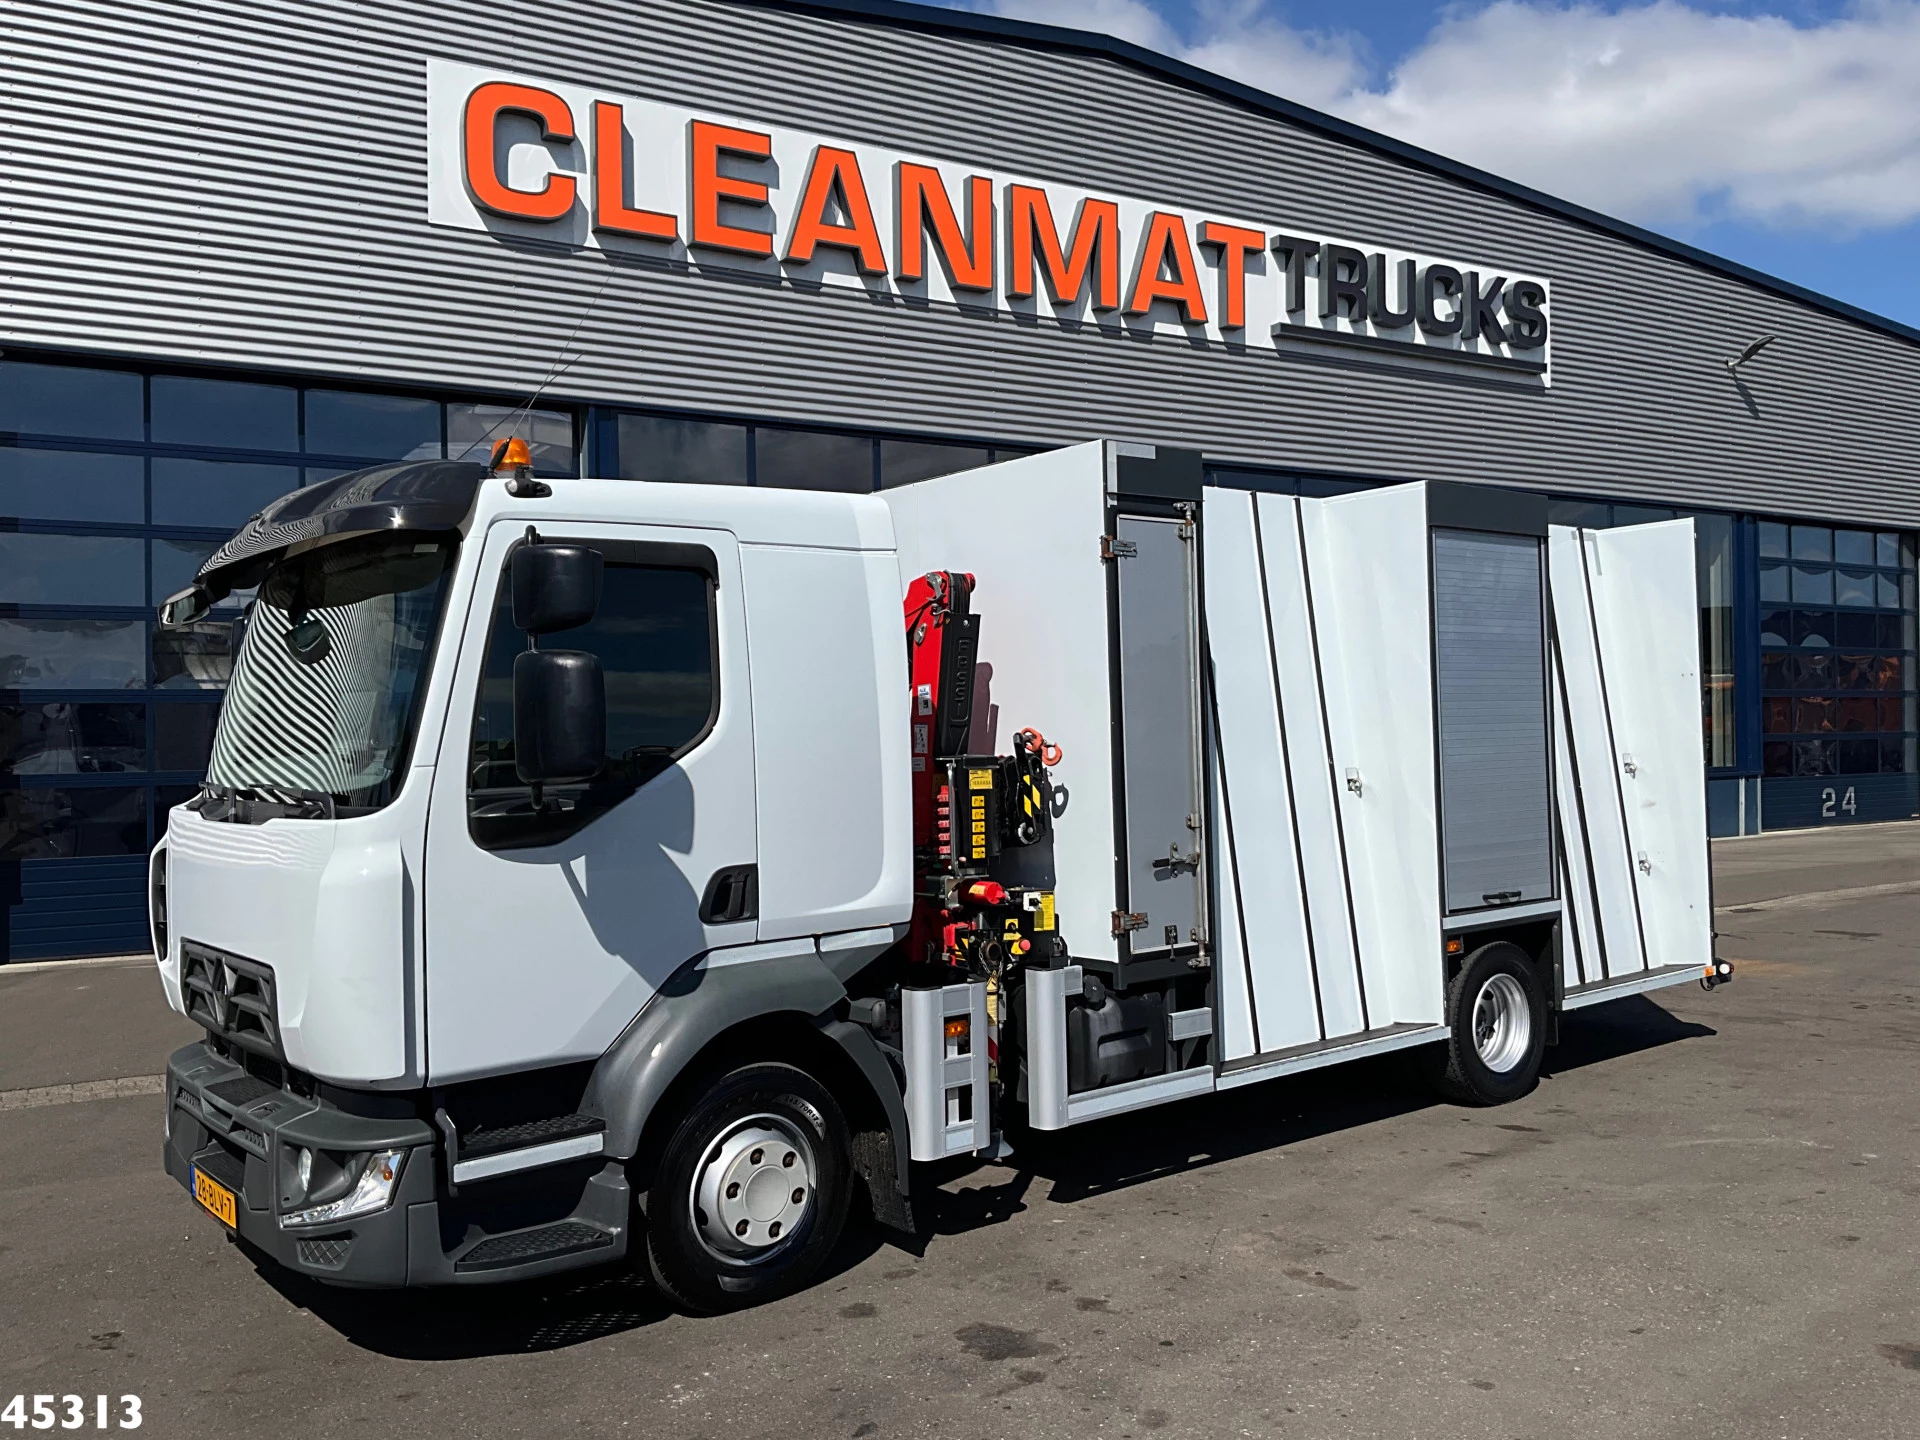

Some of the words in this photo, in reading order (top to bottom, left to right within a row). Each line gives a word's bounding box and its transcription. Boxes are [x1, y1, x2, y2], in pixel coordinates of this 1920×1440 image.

[462, 81, 1265, 330] CLEANMAT
[1270, 234, 1547, 349] TRUCKS
[1822, 786, 1857, 817] 24
[196, 1173, 231, 1221] 28-BLV-7
